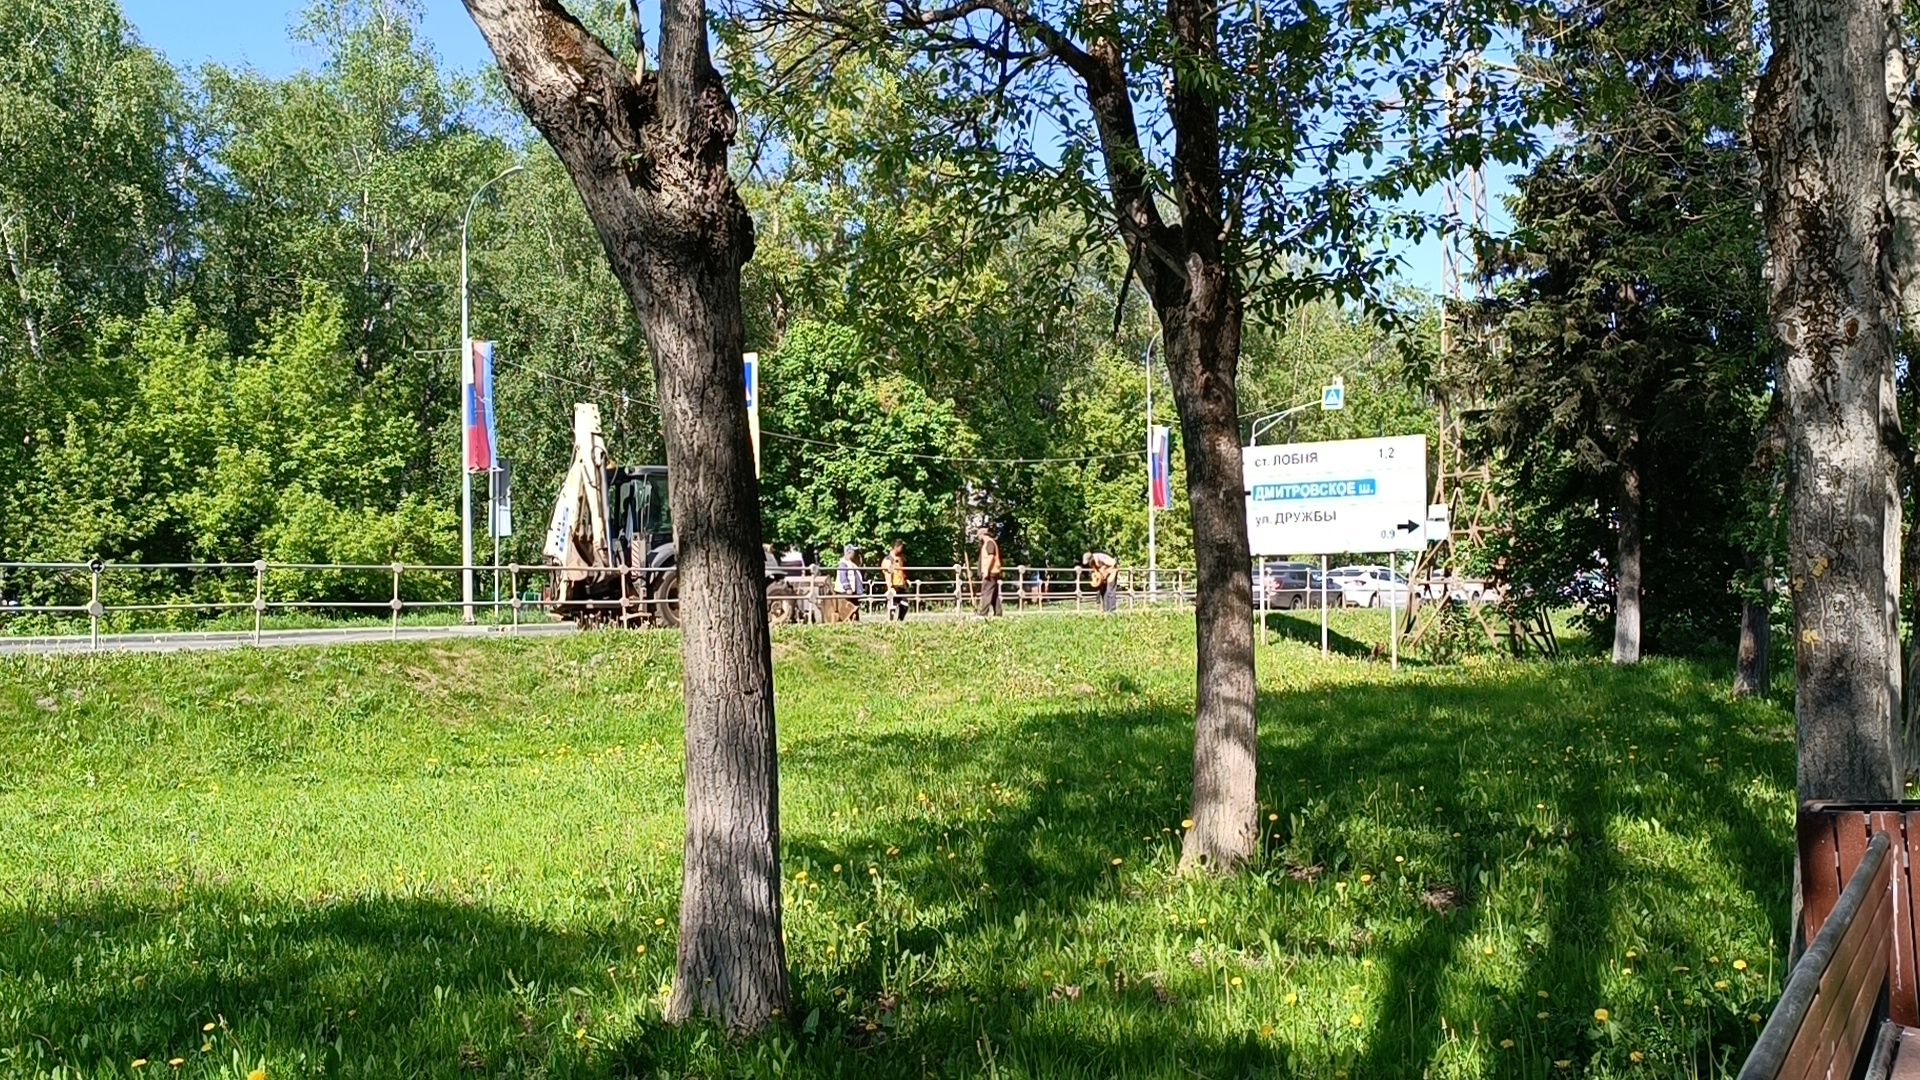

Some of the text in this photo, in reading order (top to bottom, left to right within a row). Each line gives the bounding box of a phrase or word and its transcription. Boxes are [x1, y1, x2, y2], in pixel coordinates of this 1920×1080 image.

[1254, 458, 1271, 468] ст.
[1273, 452, 1318, 466] ЛОБНЯ
[1255, 482, 1375, 501] ДМИТРОВСКОЕ ш.
[1255, 510, 1337, 527] ул. ДРУЖБЫ
